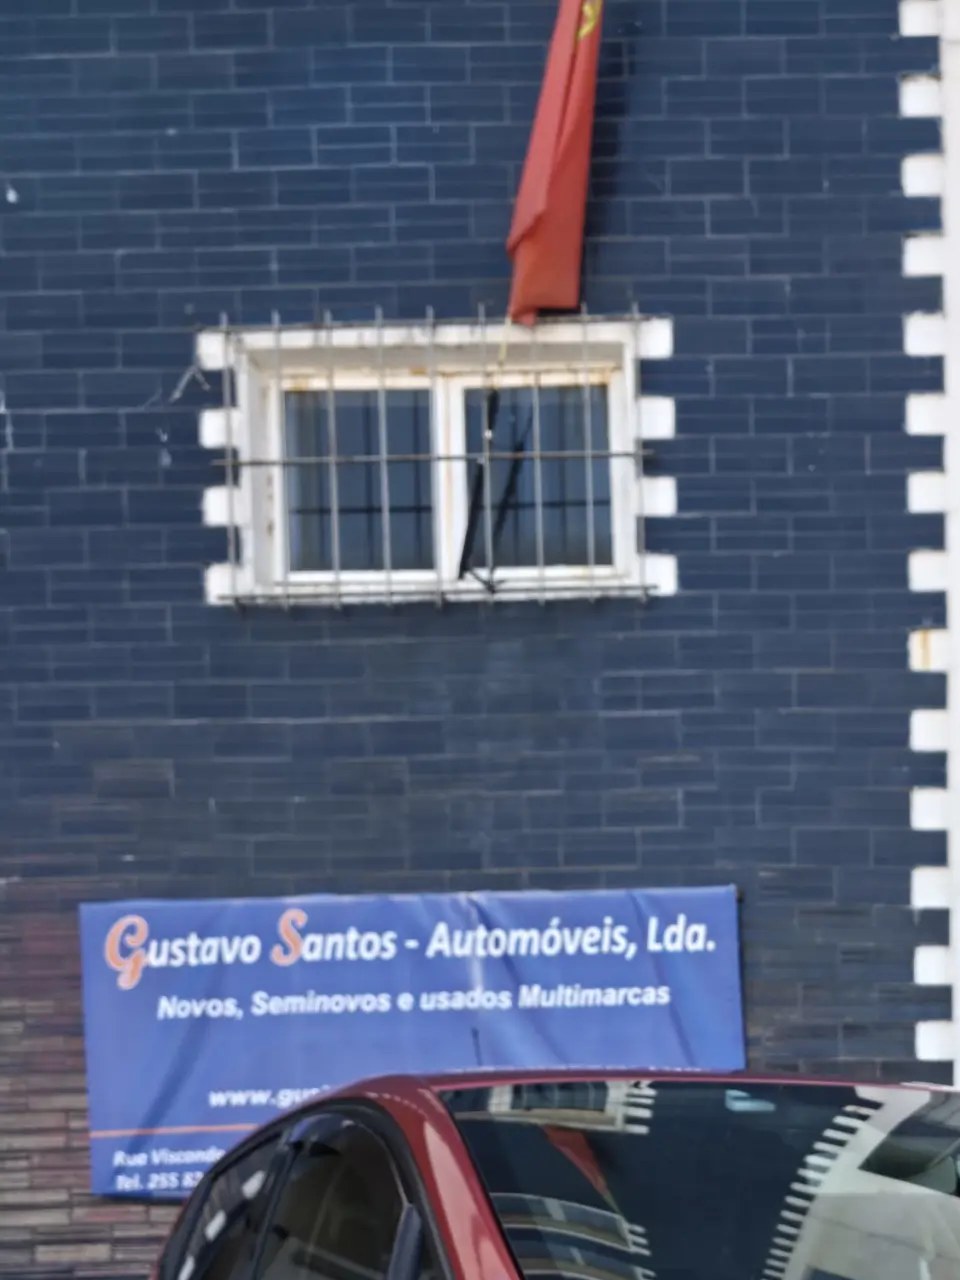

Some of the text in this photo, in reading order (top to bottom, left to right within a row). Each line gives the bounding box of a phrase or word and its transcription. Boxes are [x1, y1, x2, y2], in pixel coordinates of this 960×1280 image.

[104, 914, 262, 990] Gustavo
[270, 908, 398, 967] Santos
[425, 916, 638, 961] Automóveis,
[646, 913, 716, 952] Lda.
[156, 984, 672, 1020] Novos, Seminovos e usados Multimarcas
